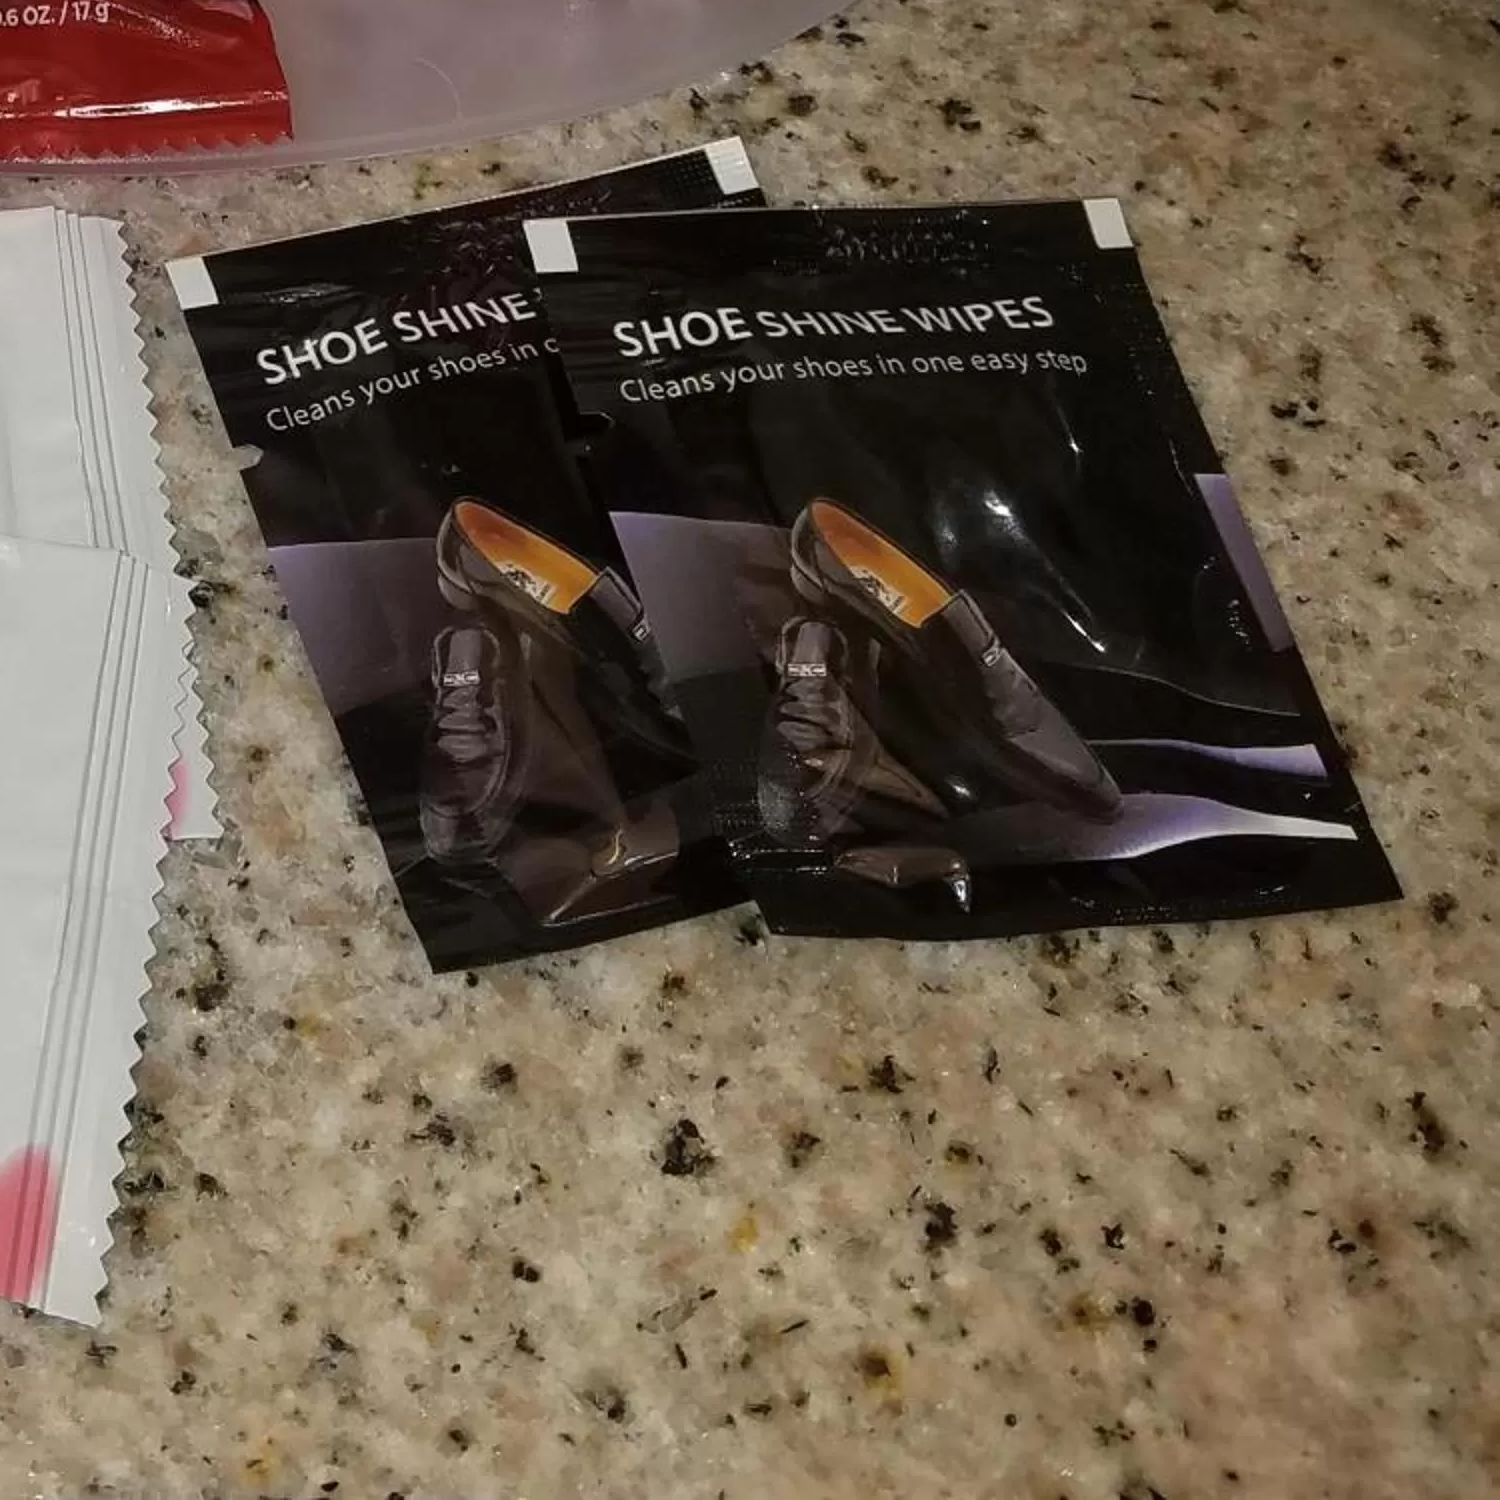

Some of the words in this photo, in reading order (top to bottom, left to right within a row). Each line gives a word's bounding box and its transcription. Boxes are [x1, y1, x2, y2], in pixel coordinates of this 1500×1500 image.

[22, 4, 56, 26] OZ.
[59, 2, 68, 26] /
[72, 0, 91, 21] 17
[94, 2, 111, 23] g
[255, 317, 388, 386] SHOE
[391, 292, 537, 343] SHINE
[612, 306, 753, 358] SHOE
[755, 308, 906, 338] SHINE
[900, 295, 1055, 332] WIPES
[265, 388, 356, 432] Cleans
[357, 366, 422, 405] your
[427, 349, 506, 381] shoes
[507, 343, 539, 362] in
[618, 371, 716, 402] Cleans
[719, 362, 785, 393] your
[792, 355, 874, 379] shoes
[875, 353, 906, 375] in
[911, 354, 965, 374] one
[970, 352, 1029, 376] easy
[1035, 349, 1088, 379] step
